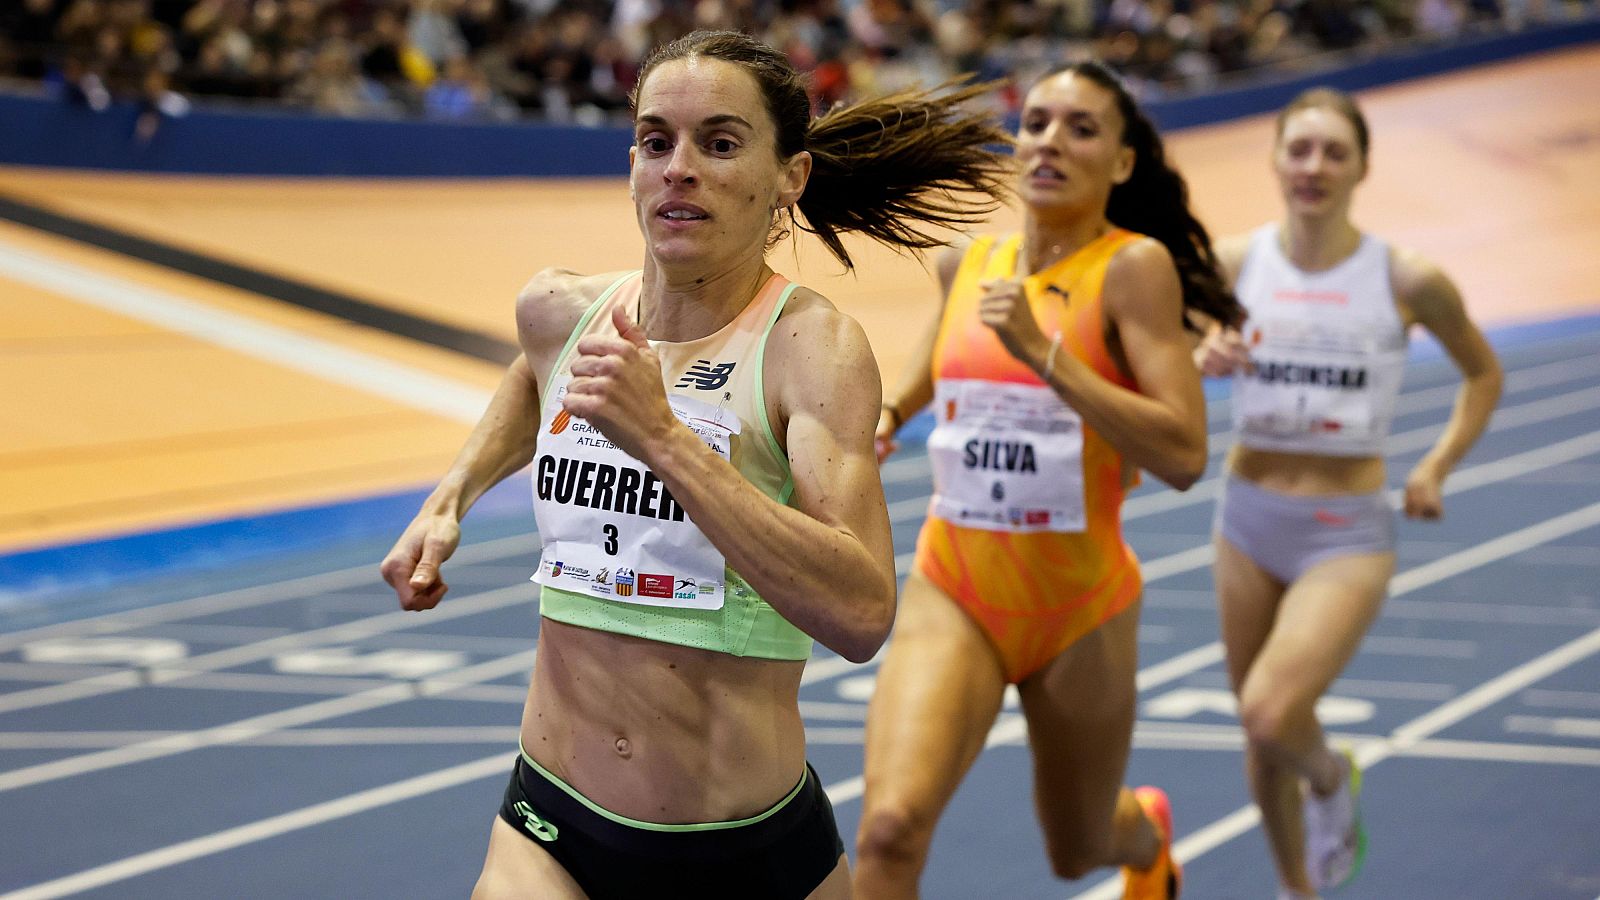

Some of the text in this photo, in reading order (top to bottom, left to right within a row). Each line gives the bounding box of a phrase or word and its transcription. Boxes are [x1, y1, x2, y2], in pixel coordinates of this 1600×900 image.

[963, 439, 1037, 473] SILVA
[537, 455, 685, 522] GUERRER
[991, 481, 1005, 502] 6
[603, 523, 619, 556] 3
[675, 591, 696, 600] rasán
